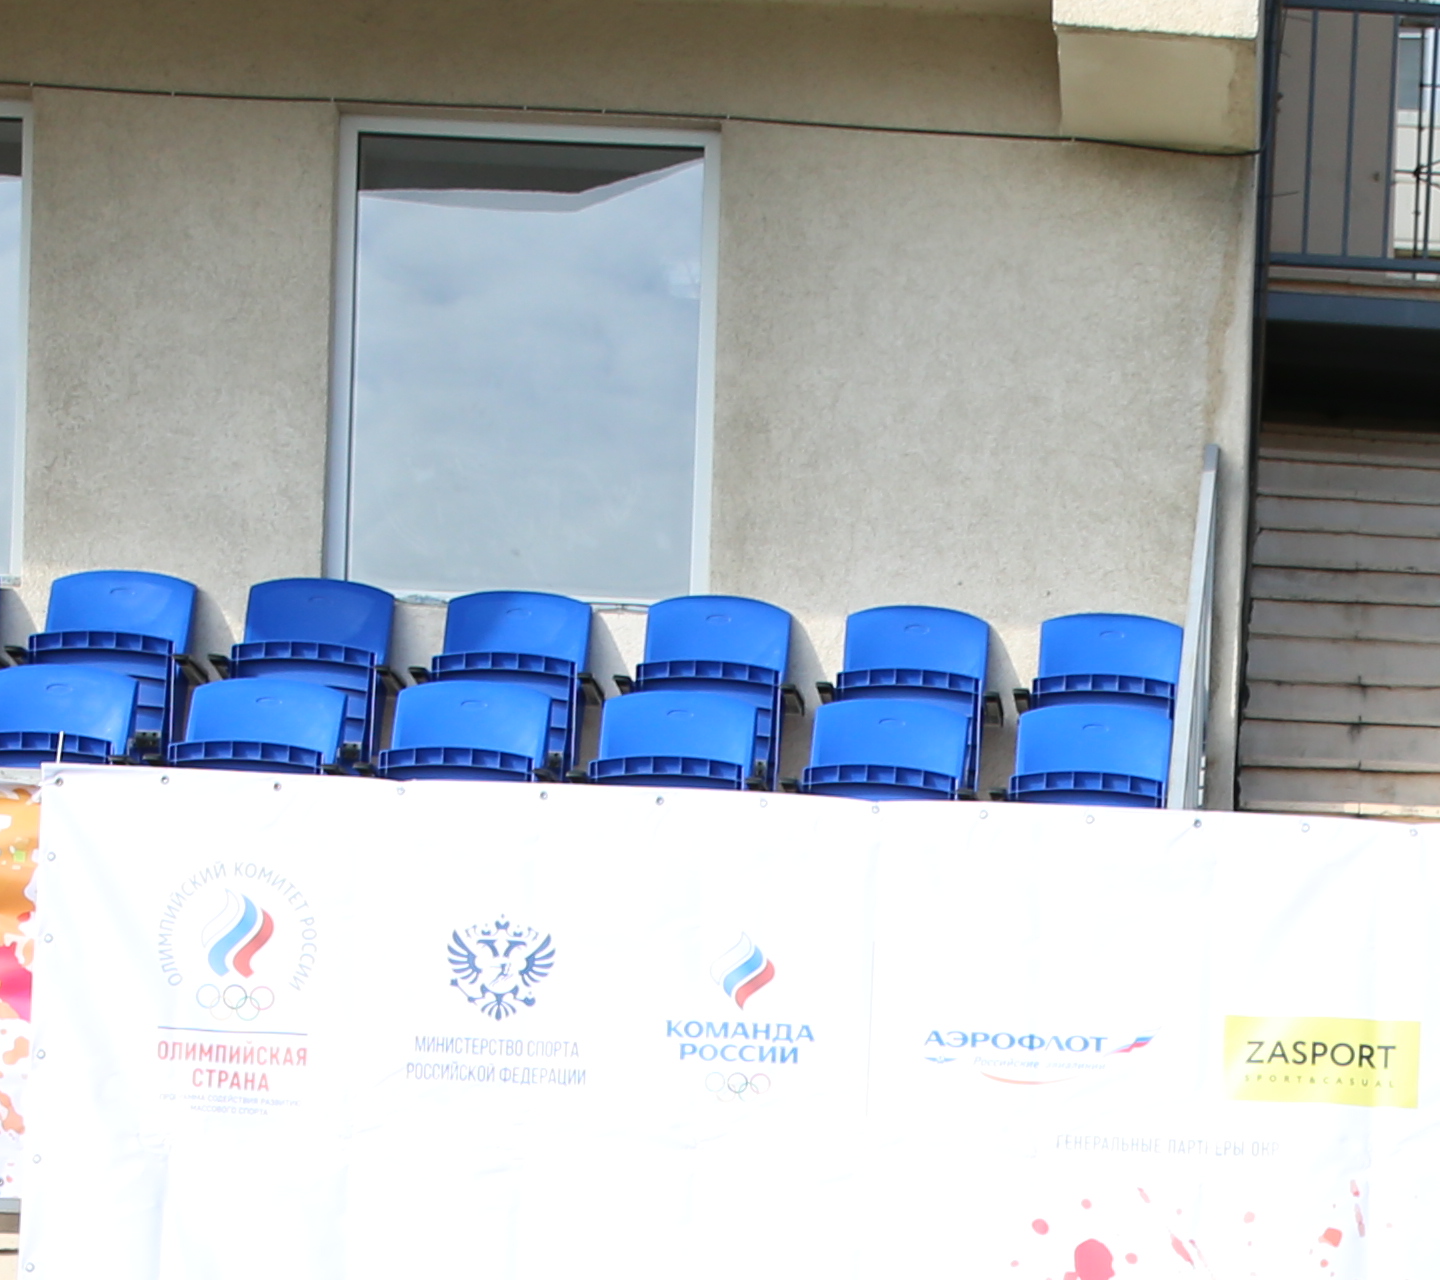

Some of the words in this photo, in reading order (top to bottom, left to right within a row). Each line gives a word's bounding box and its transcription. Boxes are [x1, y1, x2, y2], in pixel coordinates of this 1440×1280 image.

[158, 861, 226, 986] ОЛИМПИЙСКИЙ
[234, 862, 309, 911] КОМИТЕТ
[289, 917, 318, 991] РОССИИ
[666, 1019, 816, 1043] КОМАНДА
[924, 1030, 1109, 1053] АЭРОФЛОТ
[157, 1040, 308, 1067] ОЛИМПИЙСКАЯ
[415, 1036, 523, 1057] МИНИСТЕРСТВО
[527, 1040, 579, 1058] СПОРТА
[679, 1042, 799, 1064] РОССИИ
[1246, 1040, 1397, 1069] ZASPORT
[192, 1068, 269, 1092] СТРАНА
[406, 1061, 495, 1082] РОССИЙСКОЙ
[499, 1067, 586, 1086] ФЕДЕРАЦИИ
[1056, 1134, 1162, 1153] ГЕНЕРАЛЬНЫЕ
